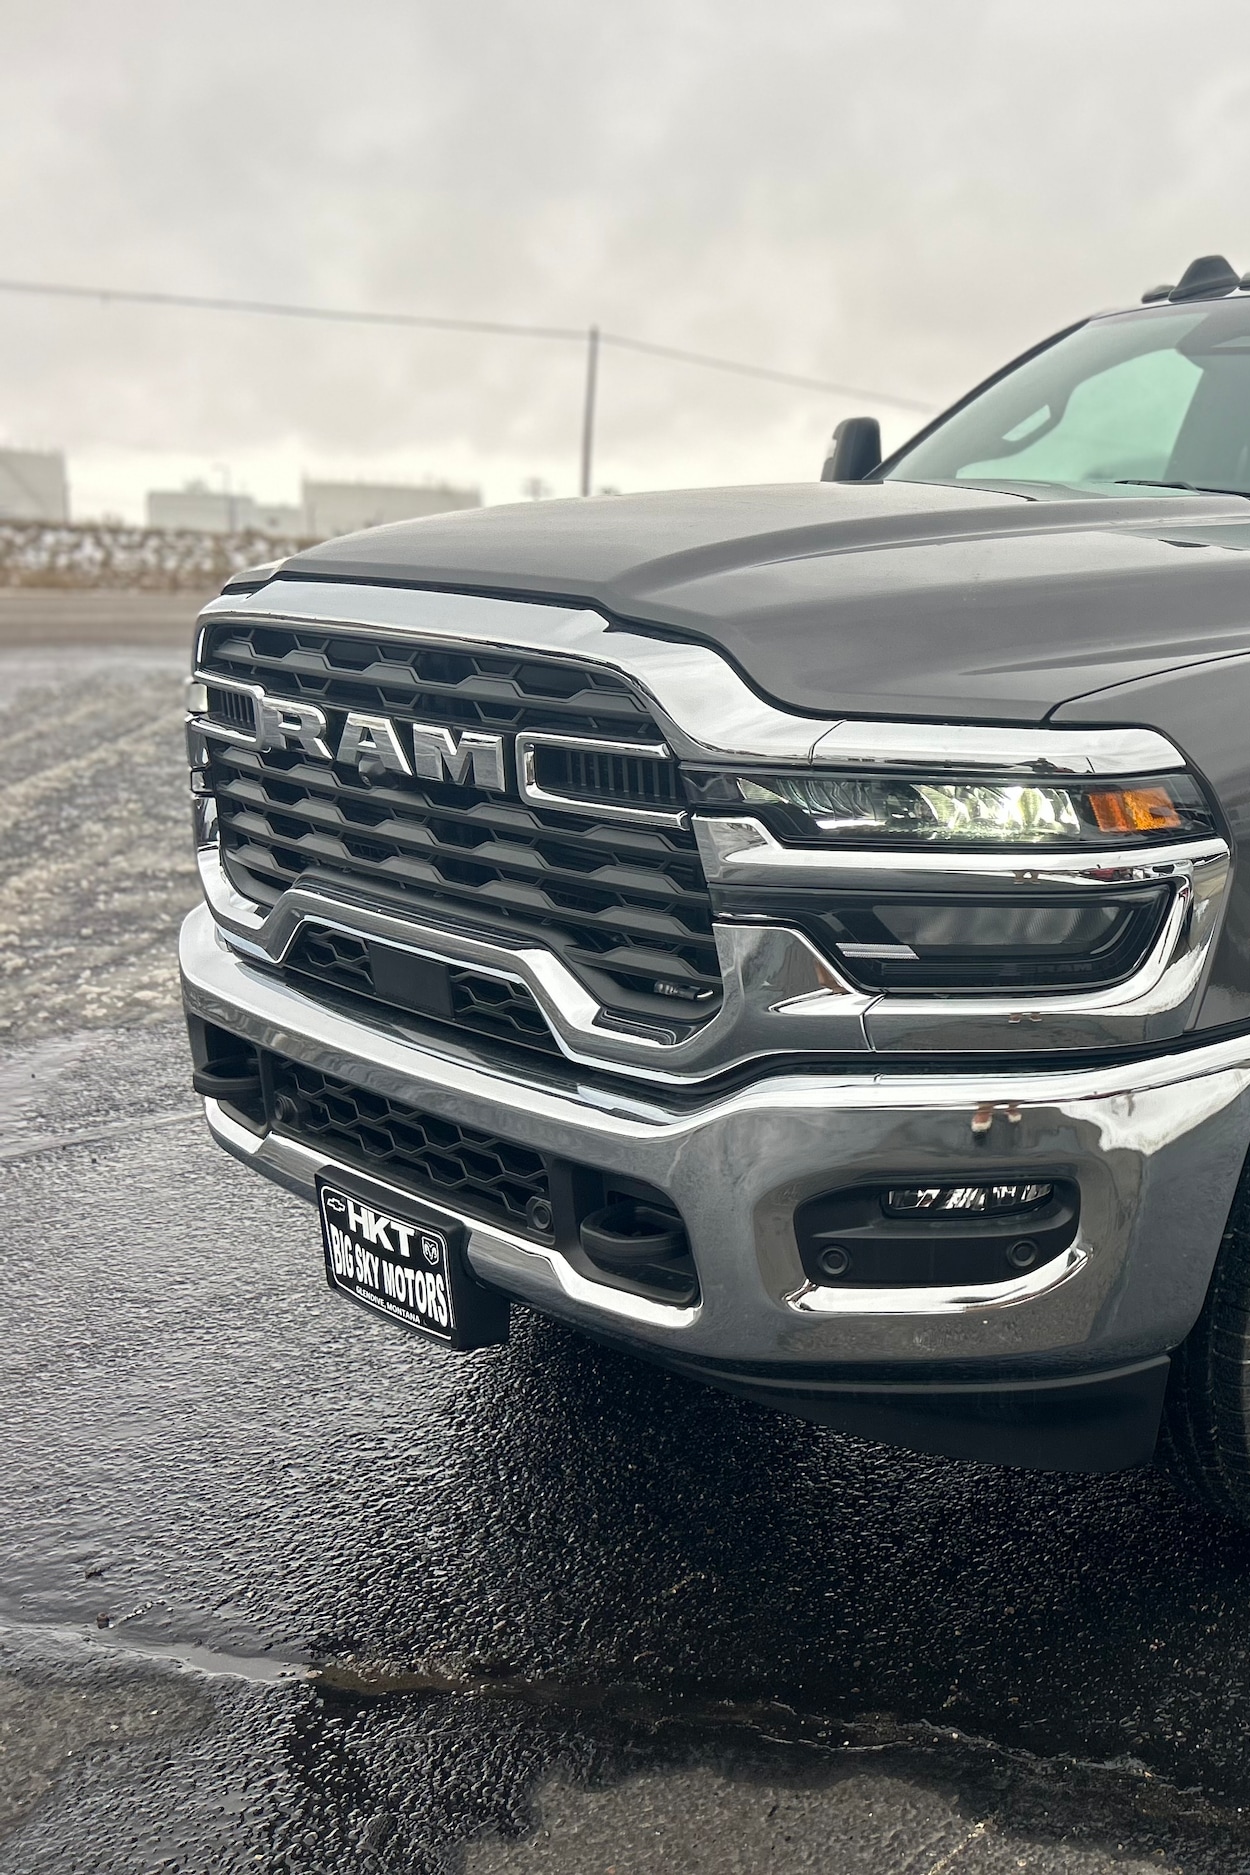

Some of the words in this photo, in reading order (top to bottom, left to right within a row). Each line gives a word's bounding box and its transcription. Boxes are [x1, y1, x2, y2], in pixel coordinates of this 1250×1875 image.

[263, 697, 505, 792] RAM
[346, 1199, 415, 1258] HKT
[330, 1223, 354, 1279] BIG
[355, 1243, 380, 1290] SKY
[382, 1260, 448, 1328] MOTORS
[355, 1285, 387, 1309] GLENDIVE,
[387, 1302, 421, 1324] MONTANA
